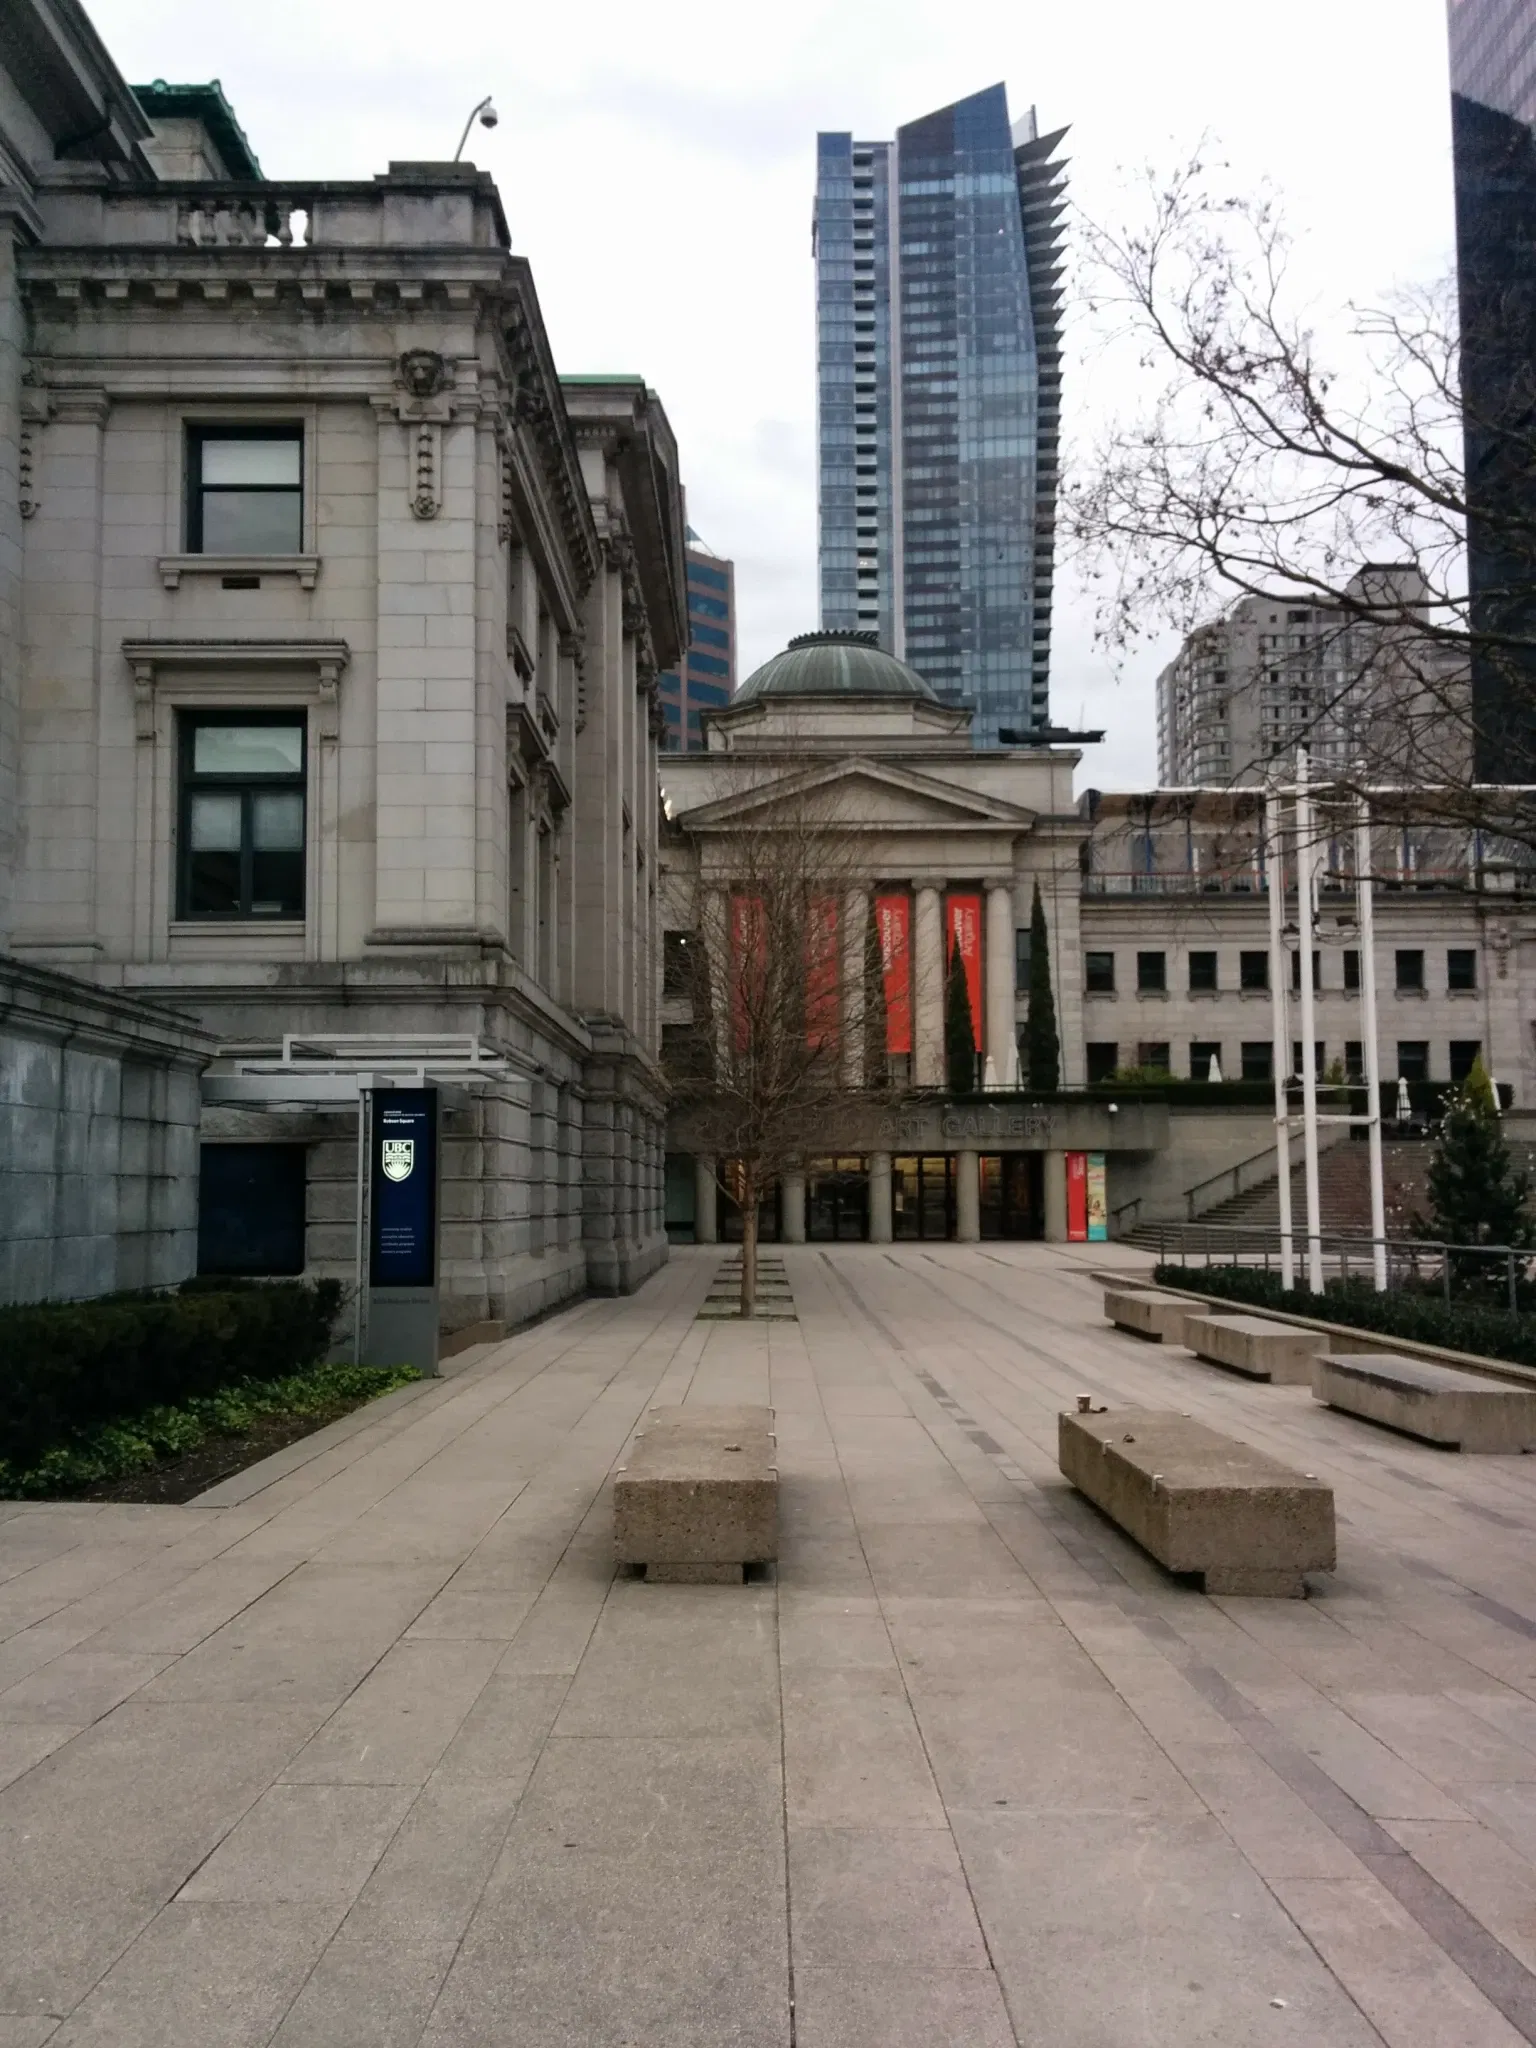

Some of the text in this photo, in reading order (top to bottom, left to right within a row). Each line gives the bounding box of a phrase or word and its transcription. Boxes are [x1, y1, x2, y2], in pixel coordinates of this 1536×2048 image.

[878, 1116, 929, 1138] ART
[942, 1115, 1056, 1138] GALLERY
[386, 1142, 411, 1153] UBC
